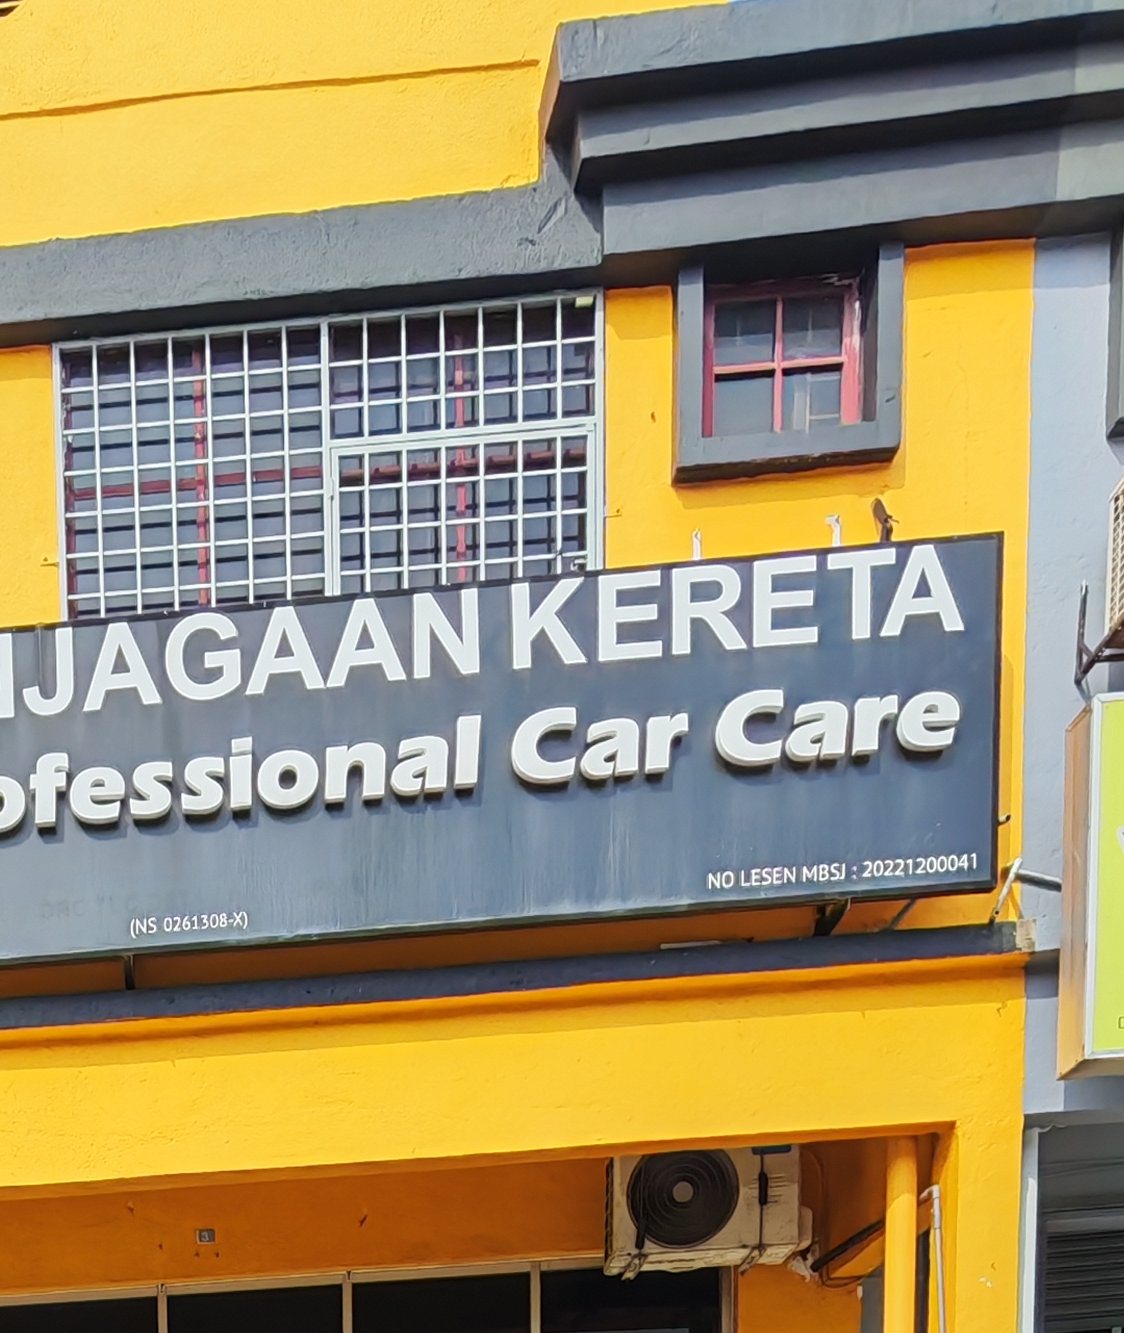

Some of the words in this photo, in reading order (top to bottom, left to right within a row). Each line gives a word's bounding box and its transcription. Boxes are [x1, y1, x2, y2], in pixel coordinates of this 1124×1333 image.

[511, 544, 965, 670] KERETA
[511, 706, 689, 785] Car
[714, 689, 960, 767] Care
[707, 871, 734, 889] NO
[740, 867, 796, 886] LESEN
[802, 863, 846, 883] MBSJ
[862, 853, 978, 878] 20221200041
[130, 917, 157, 939] (NS
[163, 911, 248, 934] 0261308-X)
